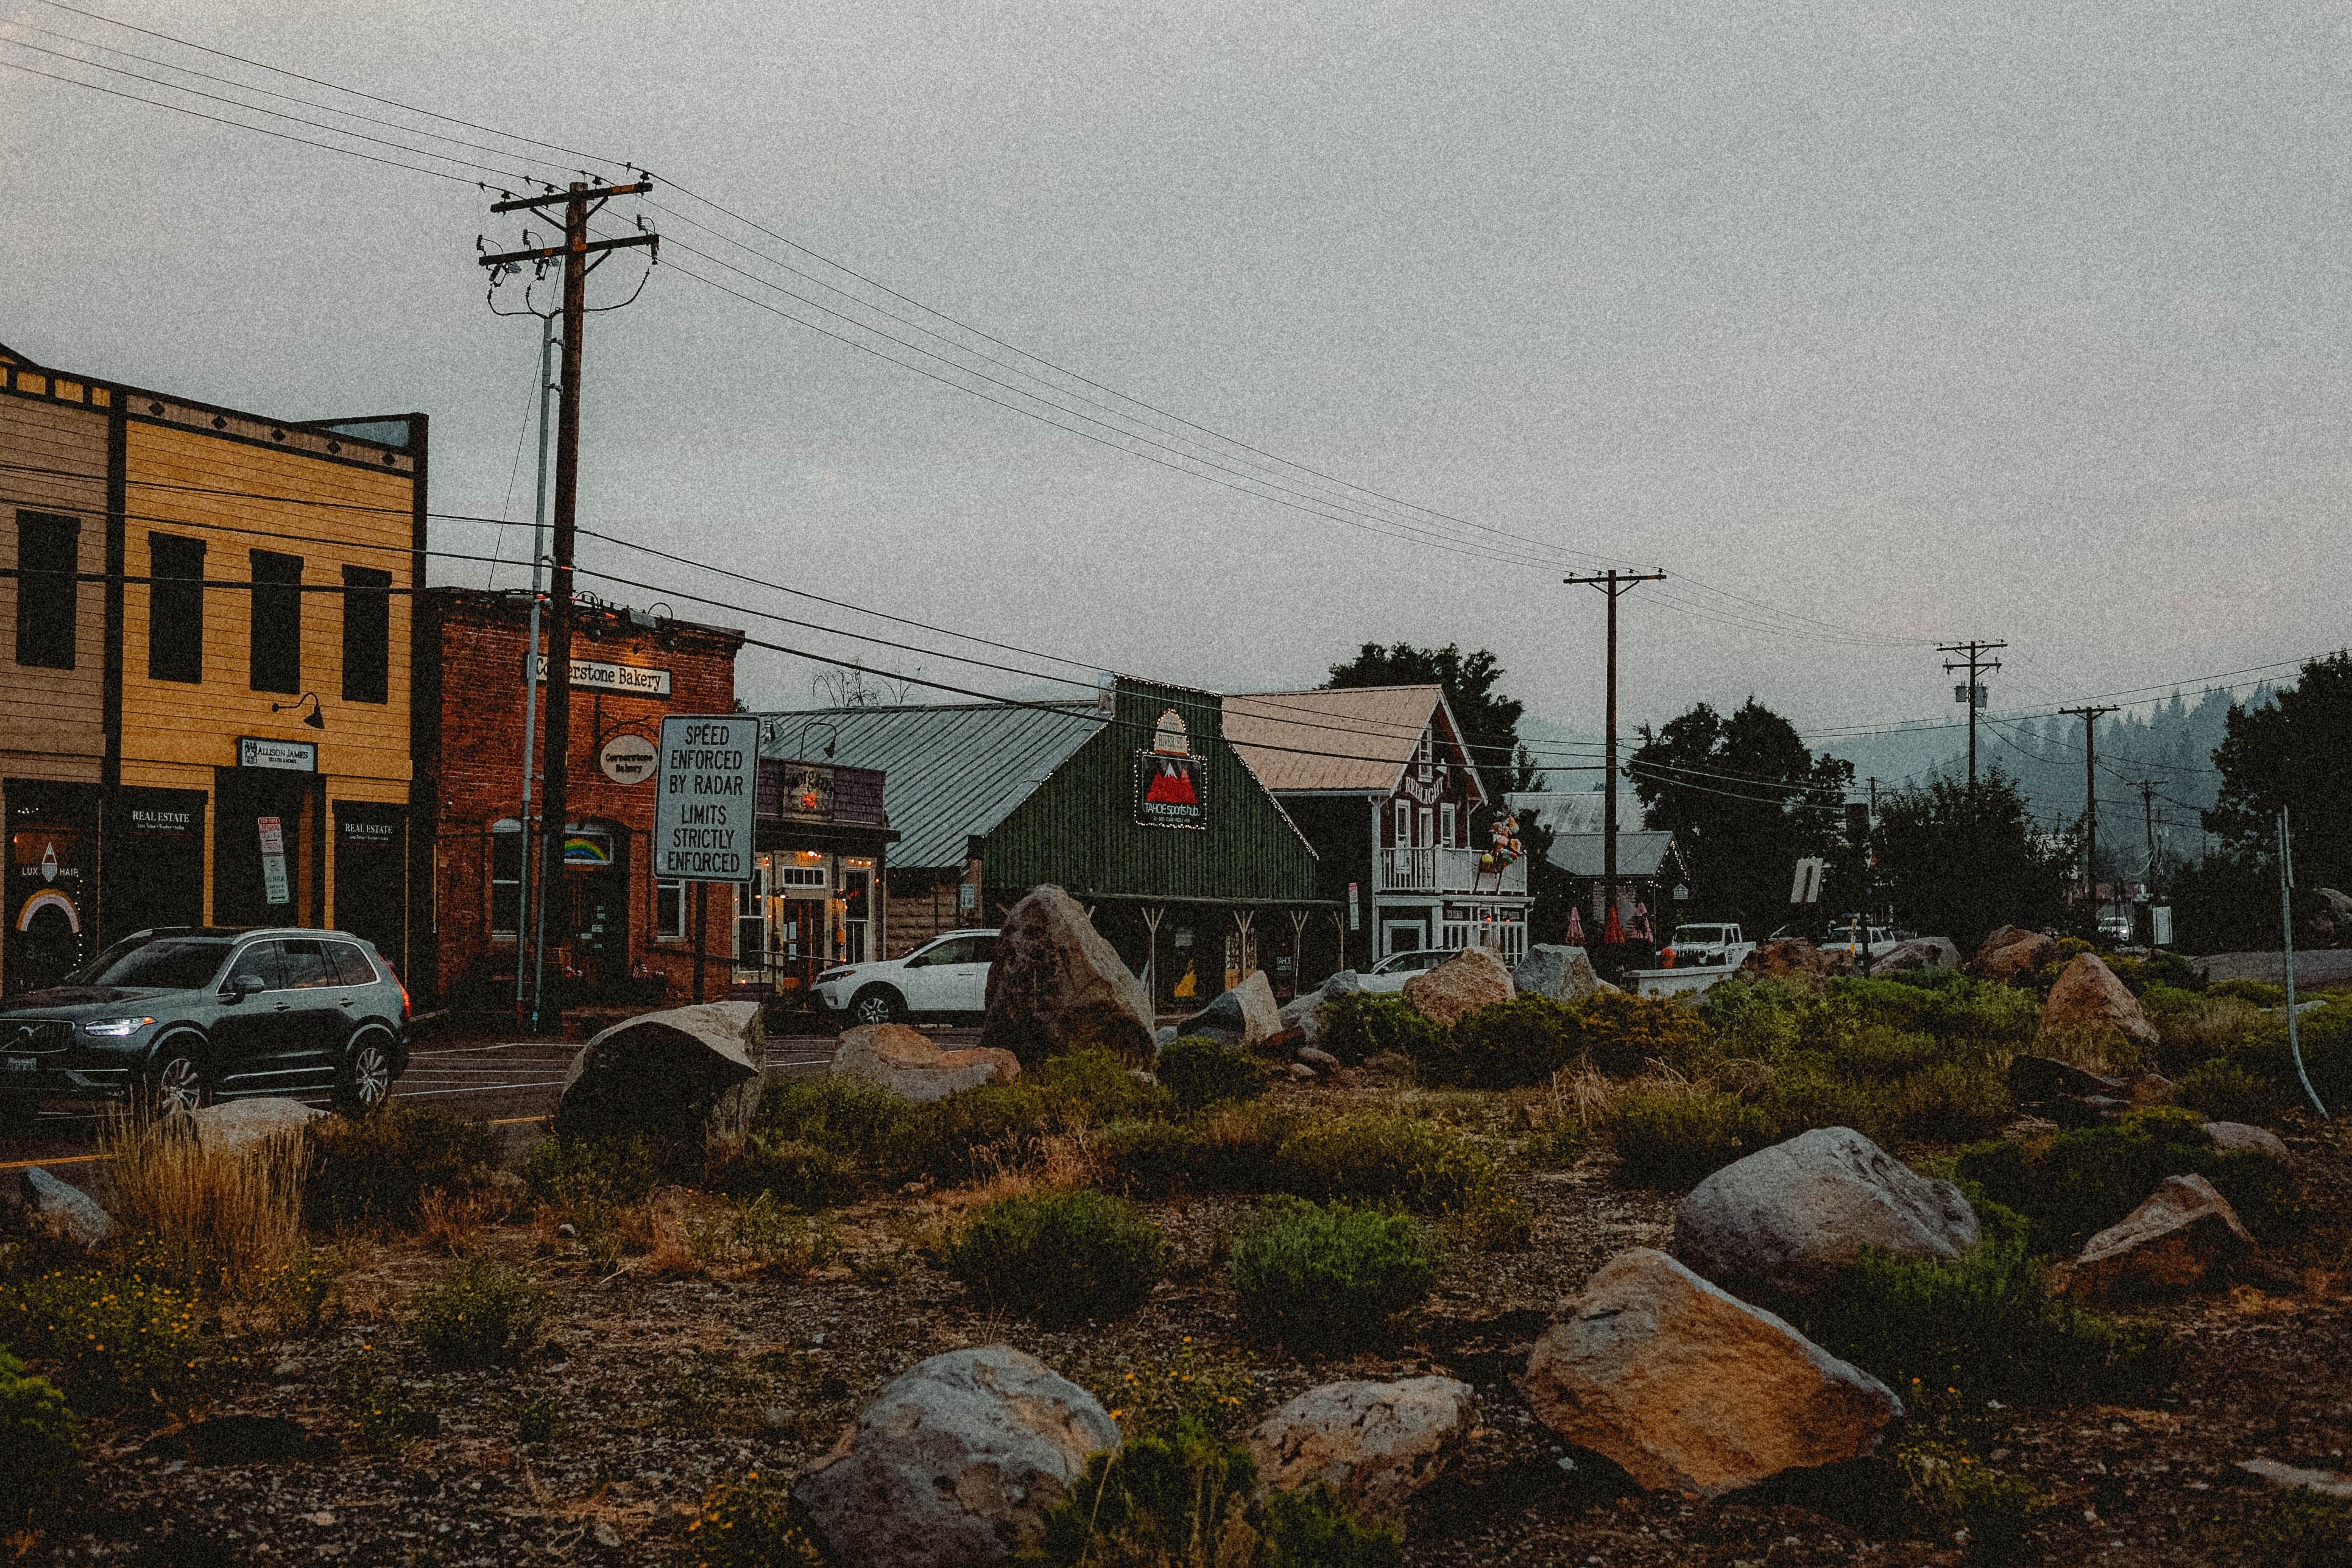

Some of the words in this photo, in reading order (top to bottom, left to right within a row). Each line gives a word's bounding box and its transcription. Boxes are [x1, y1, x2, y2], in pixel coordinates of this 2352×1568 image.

[537, 658, 615, 683] Coerstone
[619, 668, 661, 691] Bakery
[685, 725, 730, 745] SPEED
[1159, 734, 1174, 747] RIVER
[256, 746, 285, 757] ALLISON
[286, 749, 309, 759] JAMES
[671, 750, 743, 770] ENFORCED
[616, 764, 643, 774] Bakery
[669, 774, 687, 794] BY
[694, 775, 743, 796] RADAR
[681, 804, 727, 825] LIMITS
[1145, 802, 1167, 814] TAHOE
[132, 810, 157, 822] REAL
[158, 812, 190, 823] ESTATE
[345, 823, 365, 833] REAL
[366, 824, 393, 835] ESTATE
[673, 828, 735, 849] STRICTLY
[668, 850, 740, 873] ENFORCED
[22, 867, 38, 876] LUX
[59, 867, 79, 877] HAIR
